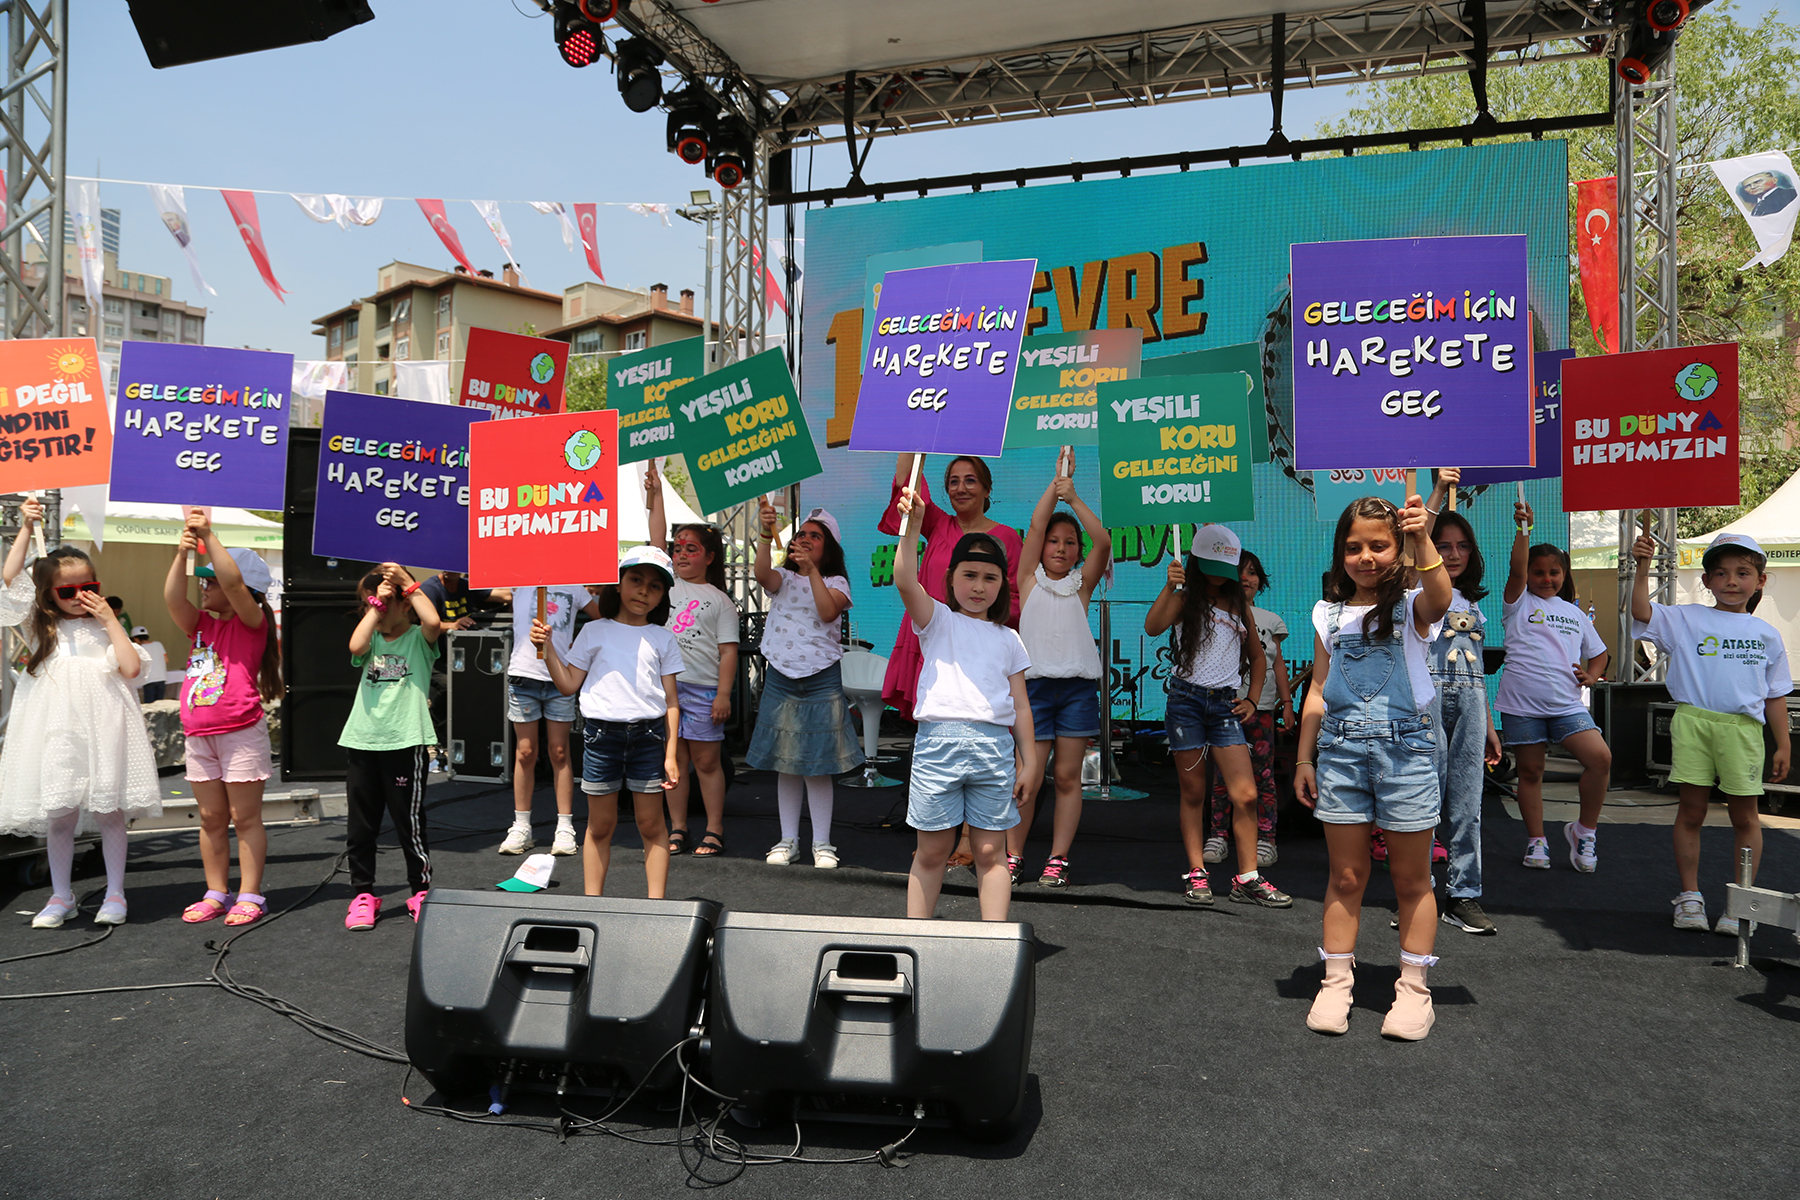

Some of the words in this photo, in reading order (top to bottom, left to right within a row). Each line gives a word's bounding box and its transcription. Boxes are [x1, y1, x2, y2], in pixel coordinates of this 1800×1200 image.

[878, 306, 975, 336] GELECEĞİM
[976, 304, 1018, 333] İÇİN
[1303, 288, 1456, 325] GELECEĞİM
[1463, 289, 1516, 322] İÇİN
[872, 341, 1009, 378] HAREKETE
[1022, 344, 1100, 368] YEŞİLİ
[1305, 332, 1515, 377] HAREKETE
[614, 357, 673, 388] YEŞİLİ
[1059, 367, 1128, 388] KORU
[15, 378, 93, 408] DEĞİL
[125, 382, 239, 407] GELECEĞİM
[243, 386, 283, 410] İÇİN
[468, 379, 491, 399] BU
[494, 383, 551, 411] DÜNYA
[679, 377, 754, 423] YEŞİLİ
[906, 387, 949, 412] GEÇ
[1014, 389, 1098, 411] GELECEĞ
[1379, 389, 1443, 419] GEÇ
[724, 394, 790, 437] KORU
[1035, 411, 1098, 431] KORU!
[1110, 394, 1201, 424] YEŞİLİ
[124, 408, 280, 445] HAREKETE
[629, 422, 675, 448] KORU!
[1159, 424, 1237, 451] KORU
[1575, 417, 1610, 440] BU
[1619, 409, 1723, 437] DÜNYA
[175, 449, 222, 473] GEÇ
[328, 434, 437, 464] GELECEĞİM
[697, 420, 798, 472] GELECEĞİNİ
[1572, 435, 1727, 466] HEPİMİZİN
[724, 449, 784, 488] KORU!
[1112, 453, 1239, 480] GELECEĞİNİ
[327, 462, 469, 506] HAREKETE
[479, 487, 509, 511] BU
[516, 480, 605, 508] DÜNYA
[1141, 480, 1212, 505] KORU!
[375, 507, 420, 532] GEÇ
[477, 508, 608, 539] HEPİMİZİN
